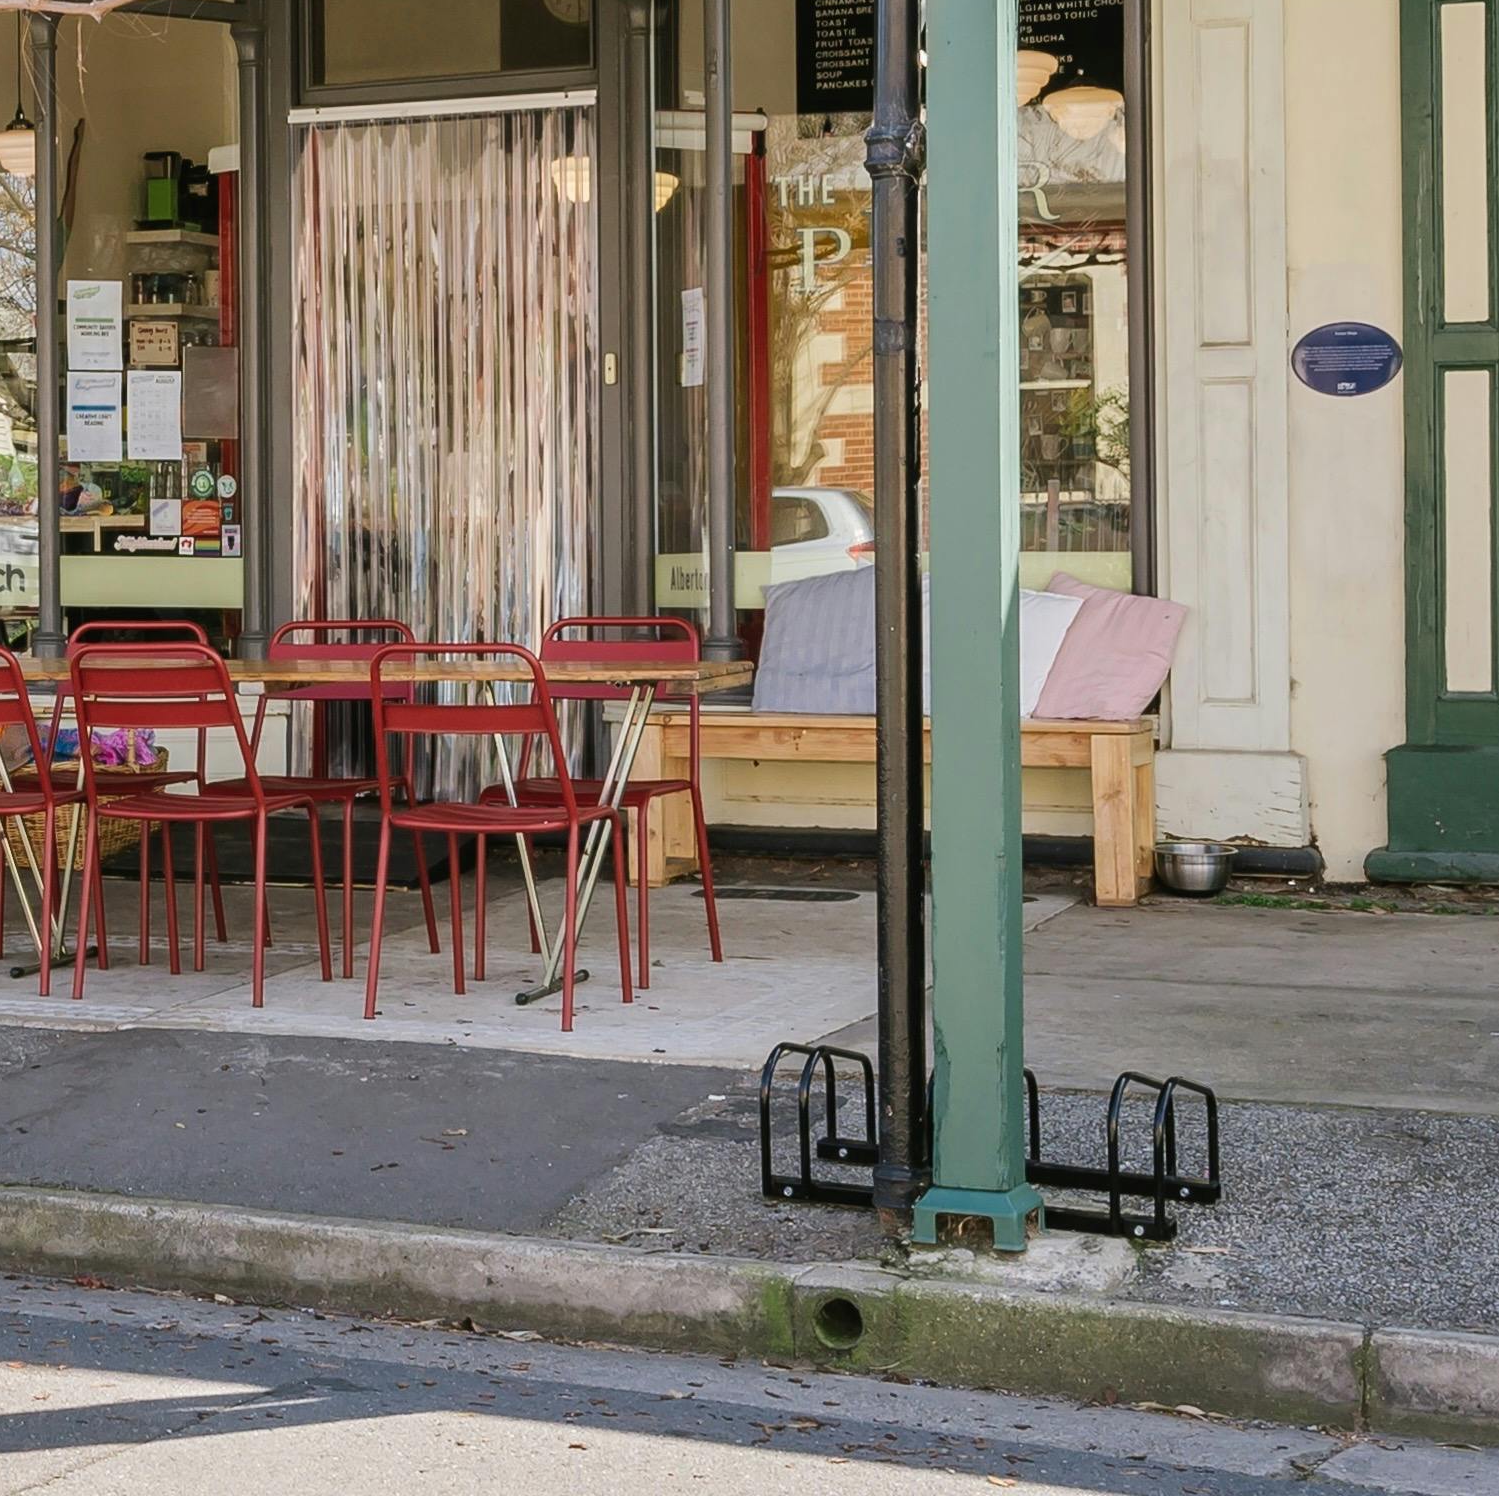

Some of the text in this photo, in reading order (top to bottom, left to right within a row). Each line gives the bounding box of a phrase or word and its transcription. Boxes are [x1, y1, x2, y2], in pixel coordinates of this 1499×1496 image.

[815, 5, 873, 18] BANANA BRE
[1019, 2, 1052, 13] LGIAN
[1056, 0, 1091, 9] WHITE
[816, 18, 848, 28] TOAST
[1019, 13, 1061, 23] PRESSO
[816, 28, 856, 38] TOASTIE
[815, 38, 873, 48] FRUIT TOAS
[1020, 34, 1065, 44] MBUCHA
[815, 48, 870, 59] CROISSANT
[815, 59, 870, 69] CROISSANT
[816, 70, 843, 80] SOUP
[816, 80, 868, 90] PANCAKES
[775, 173, 835, 208] THE
